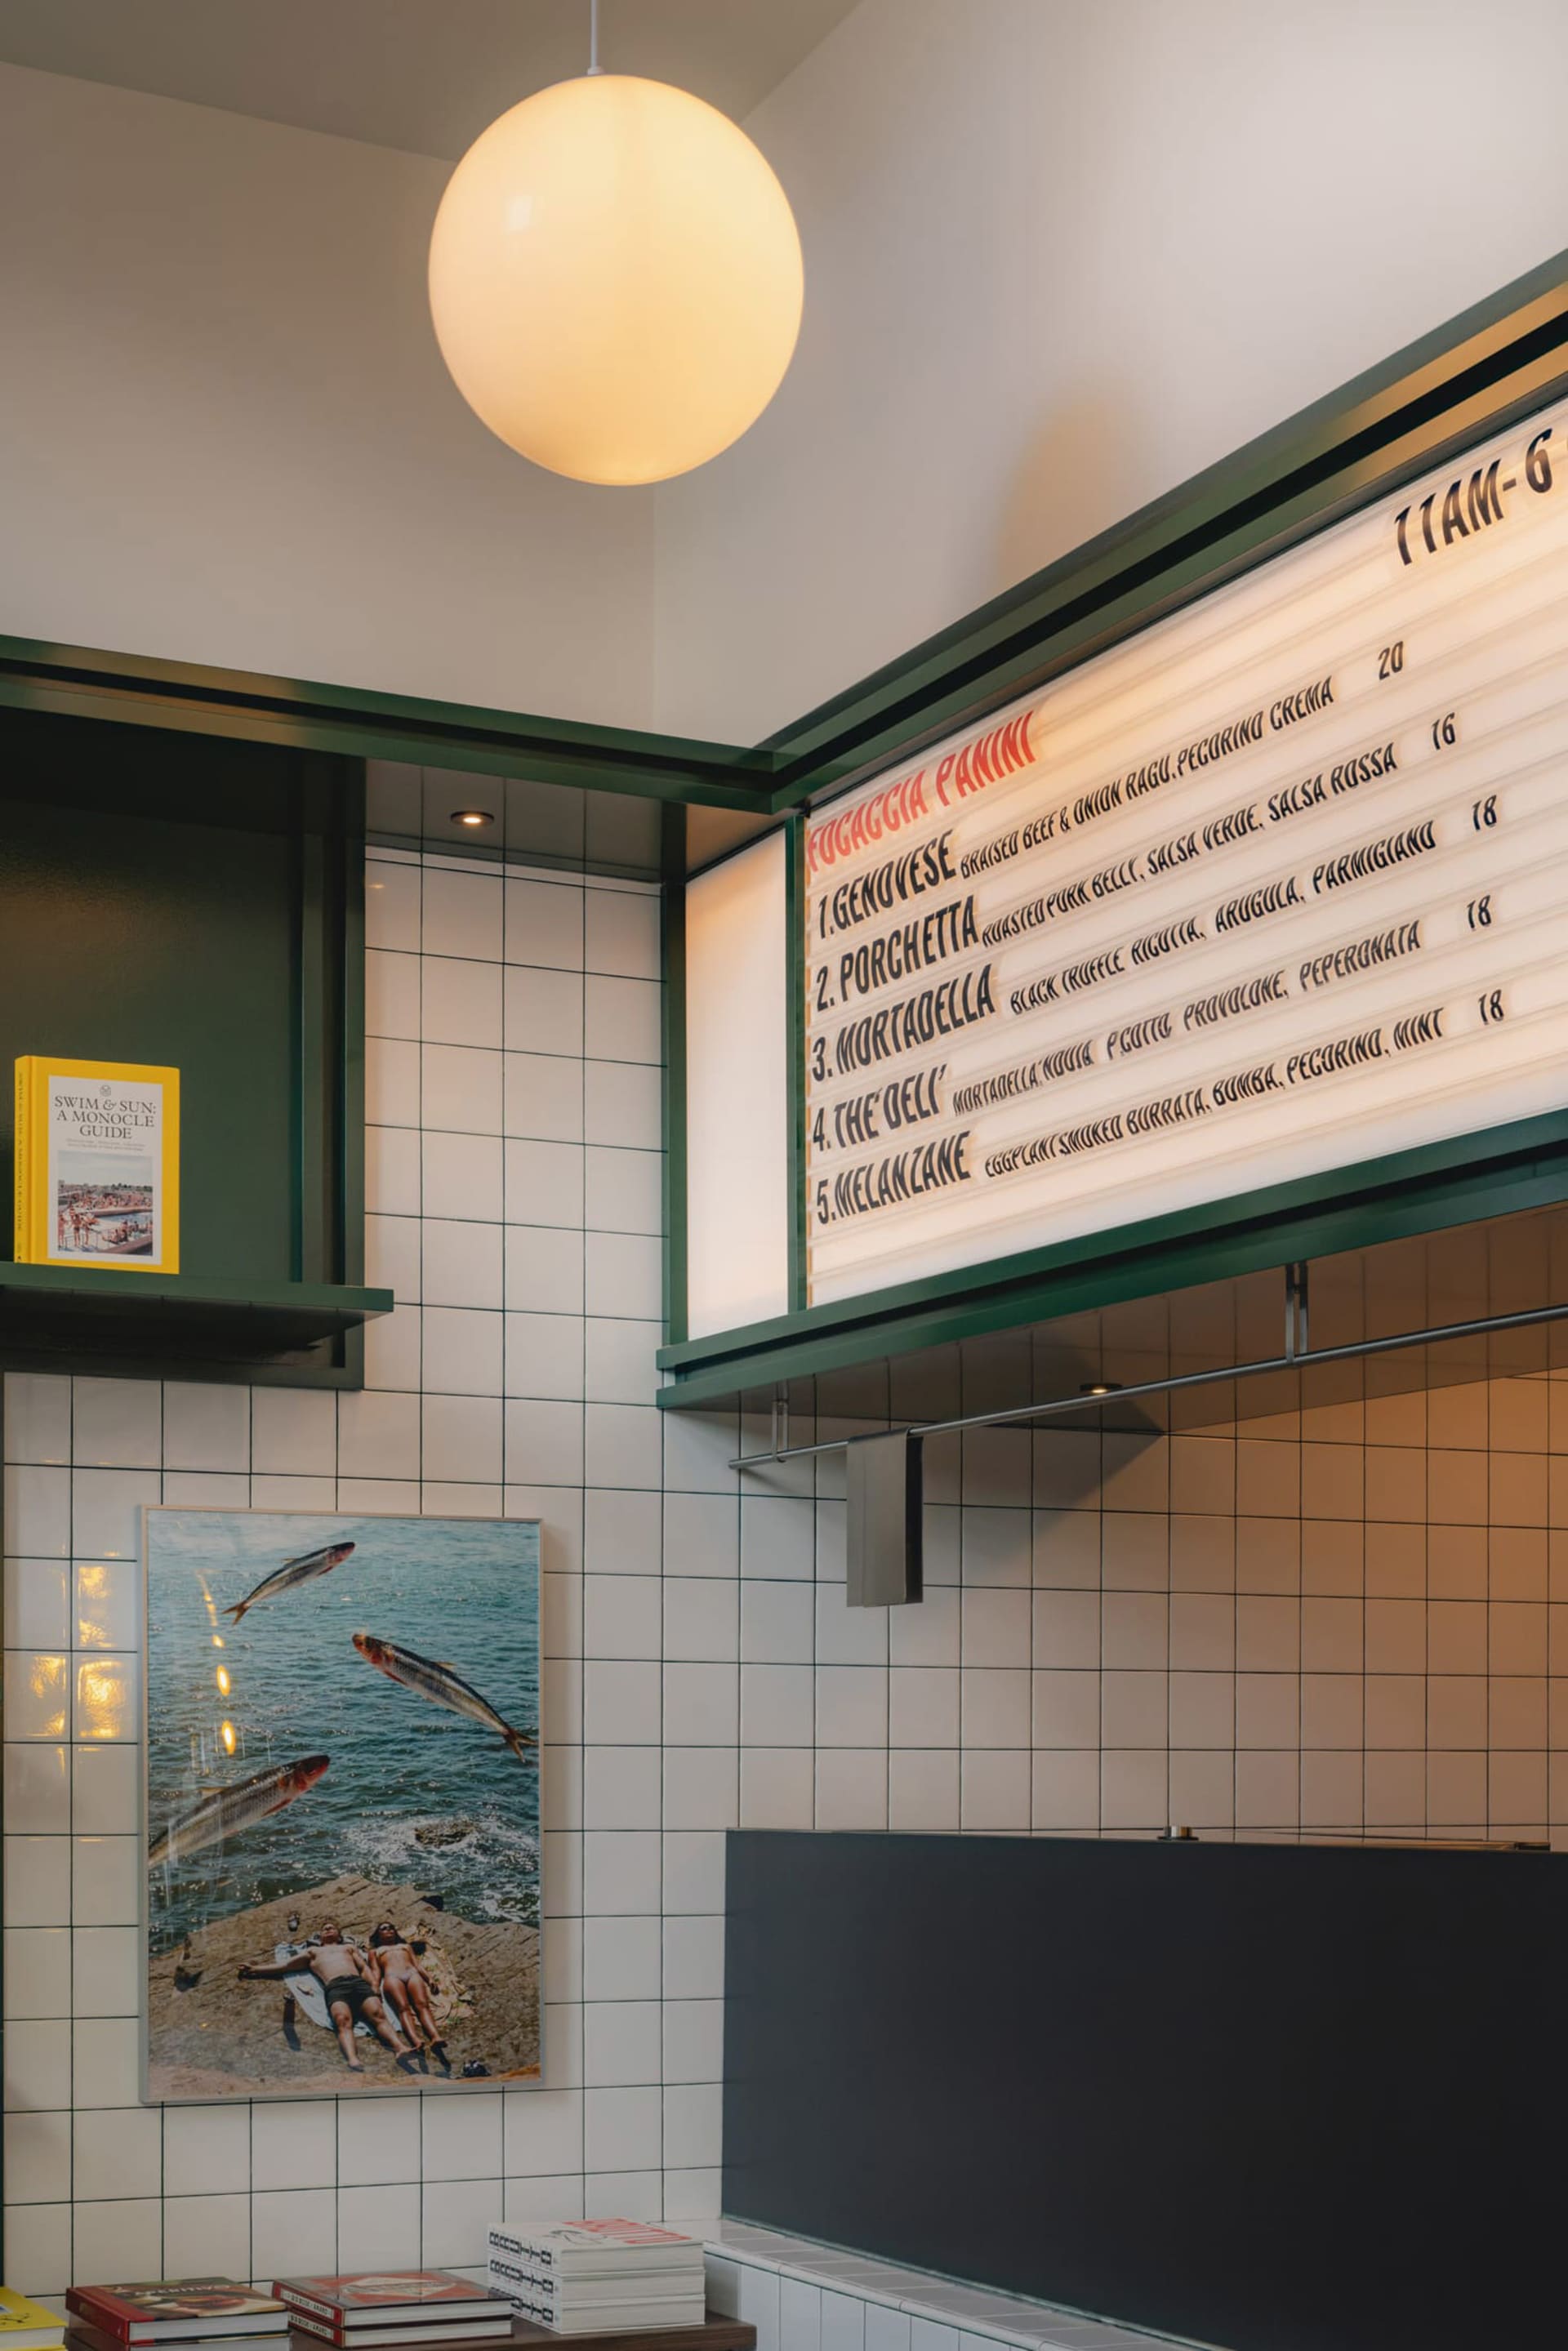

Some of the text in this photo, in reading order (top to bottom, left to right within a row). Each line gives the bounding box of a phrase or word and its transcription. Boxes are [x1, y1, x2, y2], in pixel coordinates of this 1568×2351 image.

[808, 710, 1036, 871] FOCACCIA PANINI
[960, 830, 1019, 879] BRAISED
[1022, 811, 1058, 849] BEEF
[1060, 806, 1071, 833] &
[1073, 779, 1122, 825] ONION
[1269, 675, 1334, 731] CREMA
[1378, 641, 1404, 680] 20
[812, 795, 1497, 1081] 3. MORTADELLA BLACK TRUFFLE RICOTTA, ARUGULA, PARMIGIANO 18
[816, 712, 1456, 1011] 2. PORCHETTA ROASTED PORK BELLY, SALSA VERDE, SALSA ROSSA 16
[54, 1095, 156, 1115] SWIM & SUN:
[813, 1107, 831, 1151] 4.
[1183, 969, 1289, 1031] PROVOLONE,
[1299, 920, 1421, 991] PEPERONATA
[1467, 895, 1492, 931] 18
[985, 1133, 1058, 1177] EGGPLANT
[1058, 1115, 1123, 1155] SMOKED
[1126, 1088, 1212, 1136] BURRATA,
[1213, 1062, 1285, 1106] BOMBA,
[1286, 1028, 1390, 1084] PECORINO,
[1393, 1007, 1444, 1051] MINT
[1478, 989, 1504, 1025] 18
[56, 1111, 154, 1127] A MONOCLE
[79, 1124, 132, 1139] GUIDE
